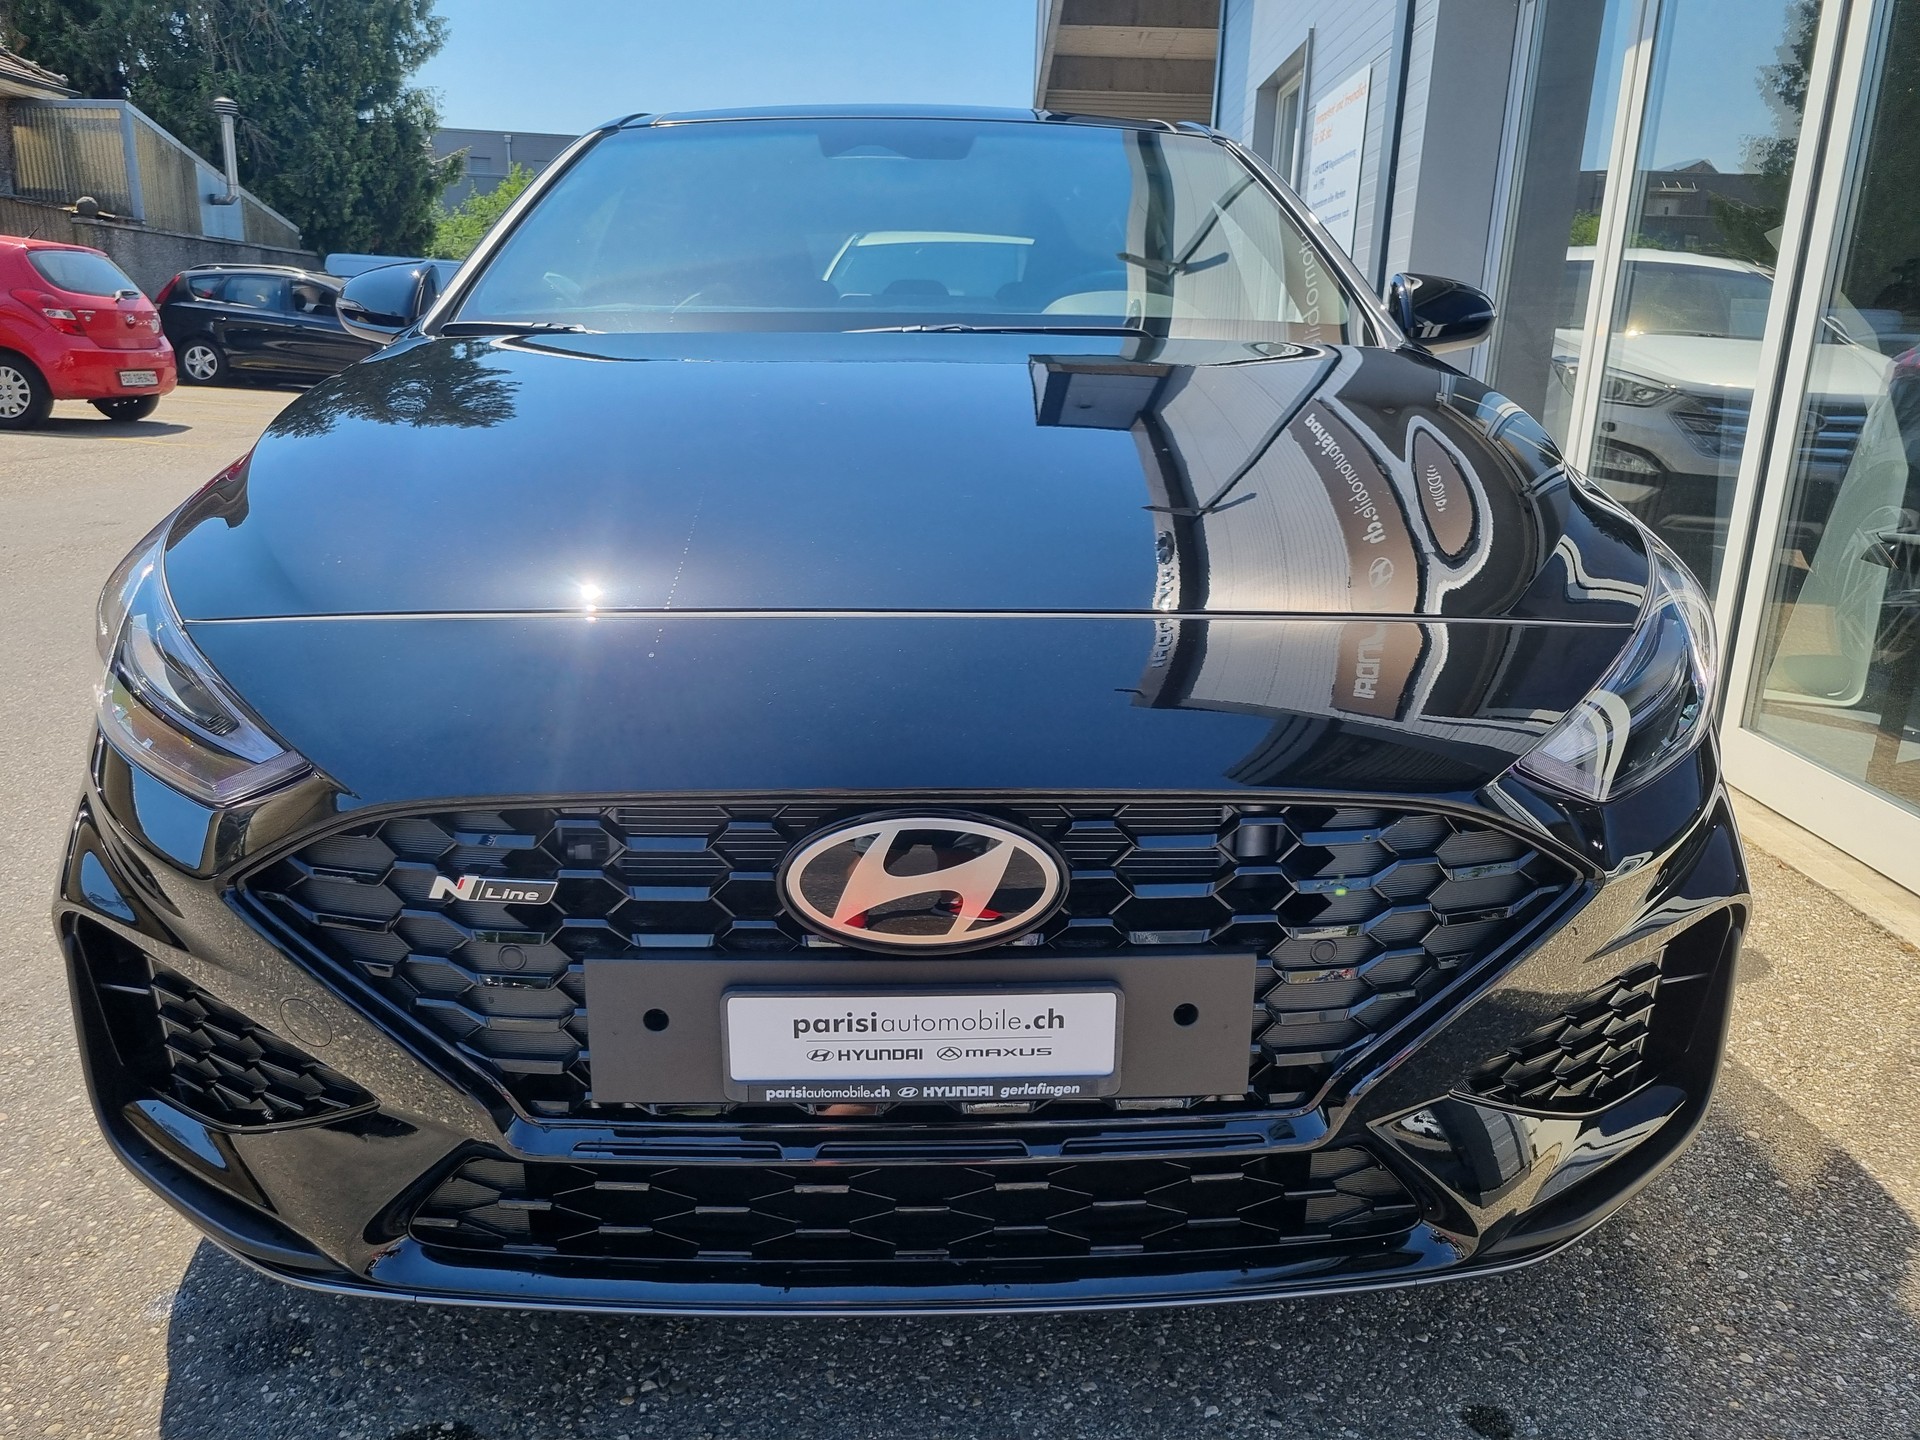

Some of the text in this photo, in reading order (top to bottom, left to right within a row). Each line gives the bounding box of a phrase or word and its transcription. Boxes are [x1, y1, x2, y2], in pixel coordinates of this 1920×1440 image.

[428, 875, 540, 900] N Line
[793, 1008, 1065, 1038] parisiautomobile.ch
[838, 1047, 1052, 1061] HYUNDAI MAXUS
[766, 1083, 1080, 1101] parisiautomobile.ch HYUNDAI gerlafingen
